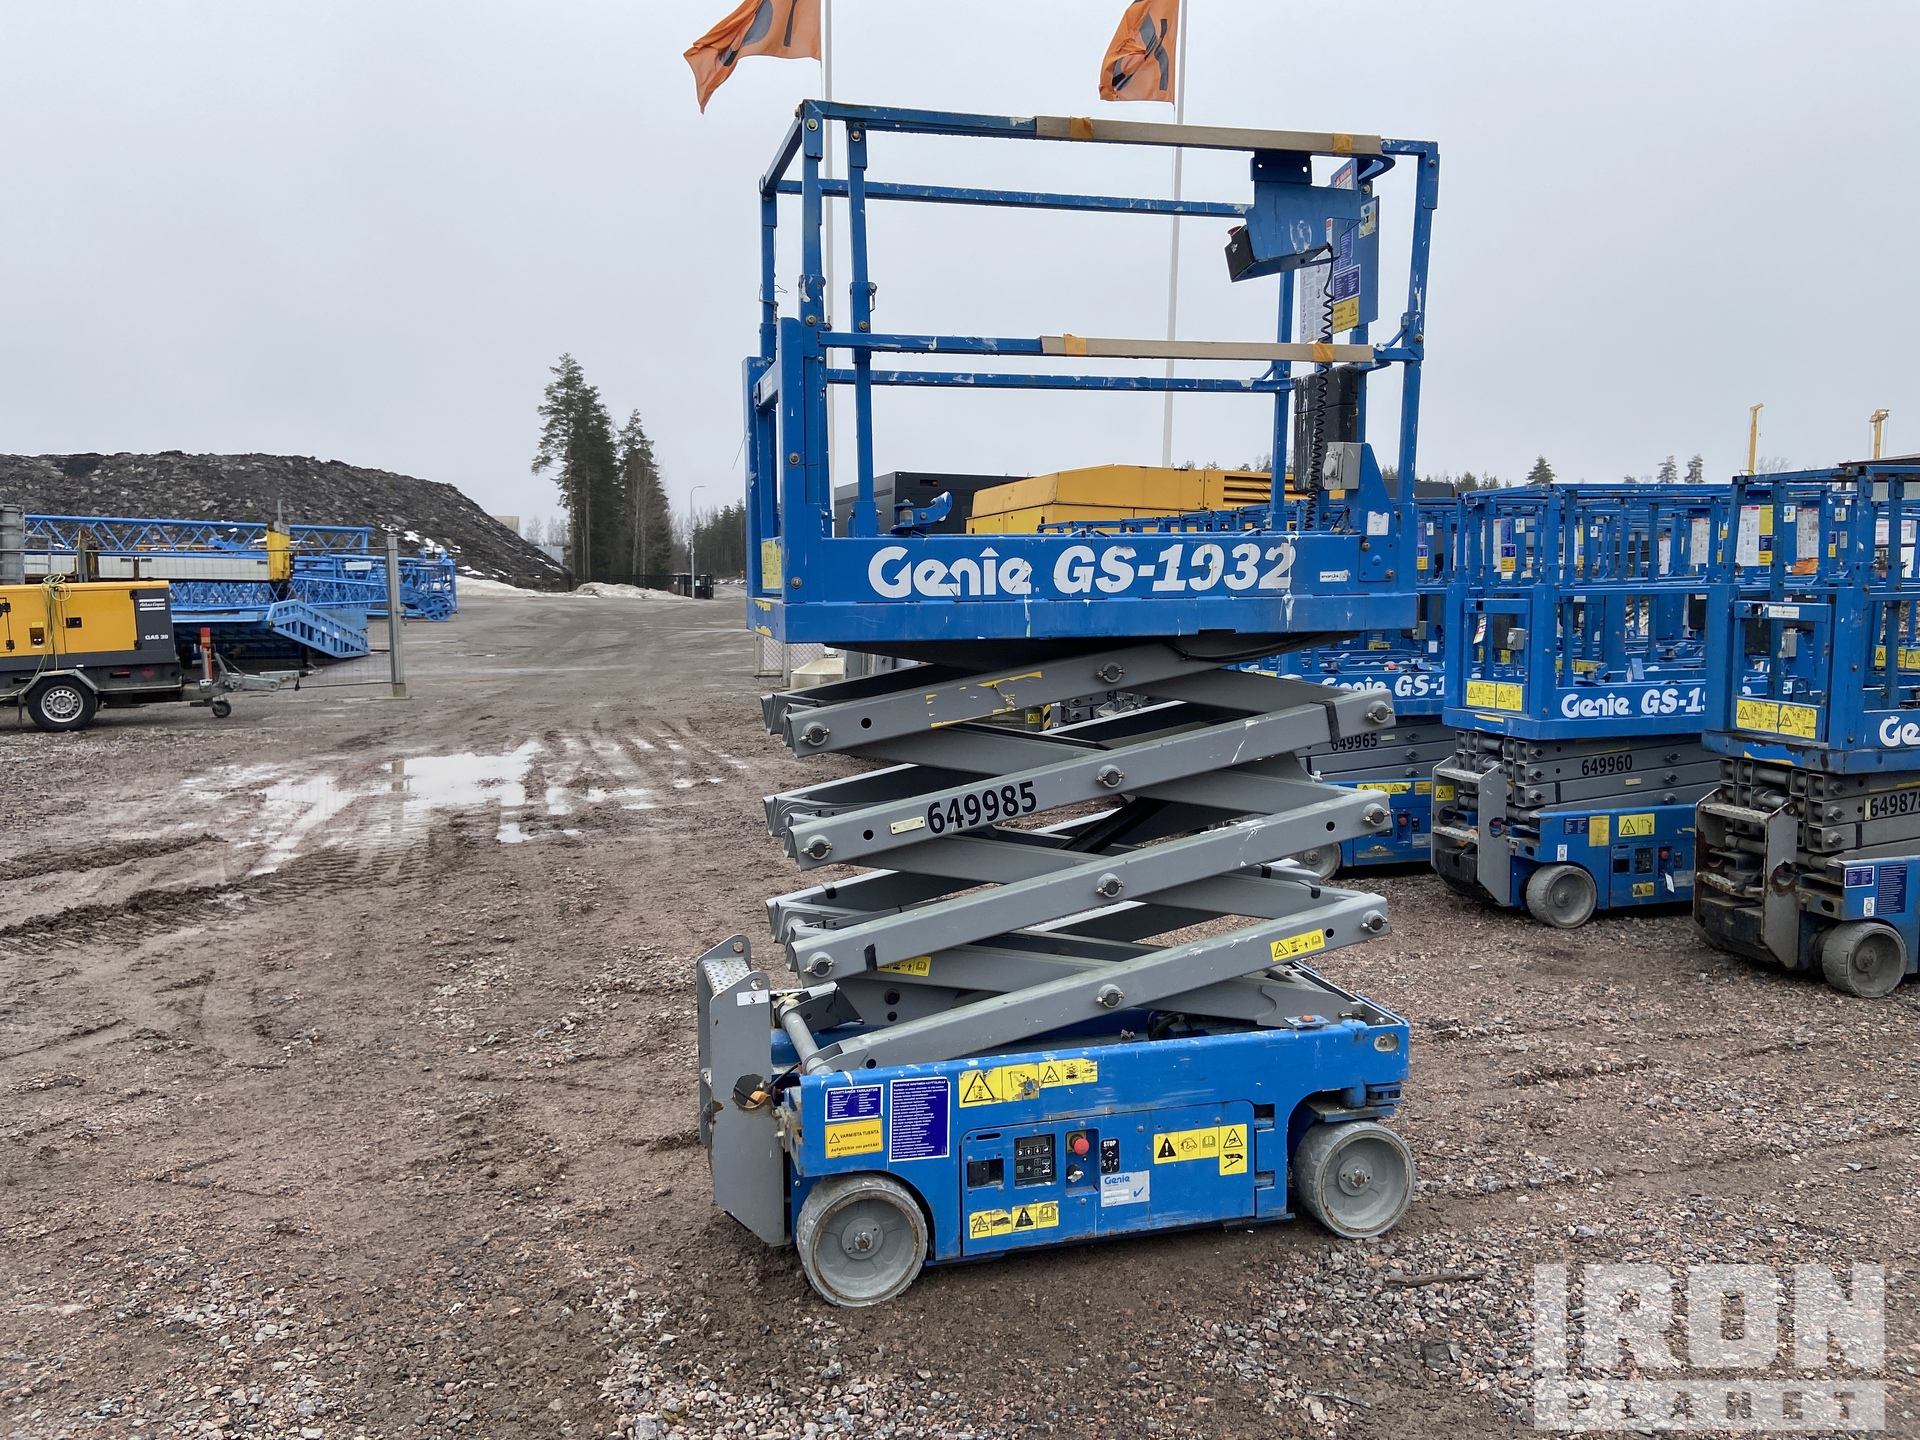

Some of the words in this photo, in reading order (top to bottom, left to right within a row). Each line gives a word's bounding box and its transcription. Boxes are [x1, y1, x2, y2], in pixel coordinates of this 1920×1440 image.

[867, 546, 1033, 599] Genie
[1053, 542, 1297, 594] GS-1932
[1560, 692, 1630, 719] Genie
[1331, 732, 1378, 751] 649965
[1581, 754, 1633, 776] 649960
[927, 780, 1037, 834] 649985
[1870, 791, 1920, 817] 64987
[1104, 1175, 1130, 1184] Genie
